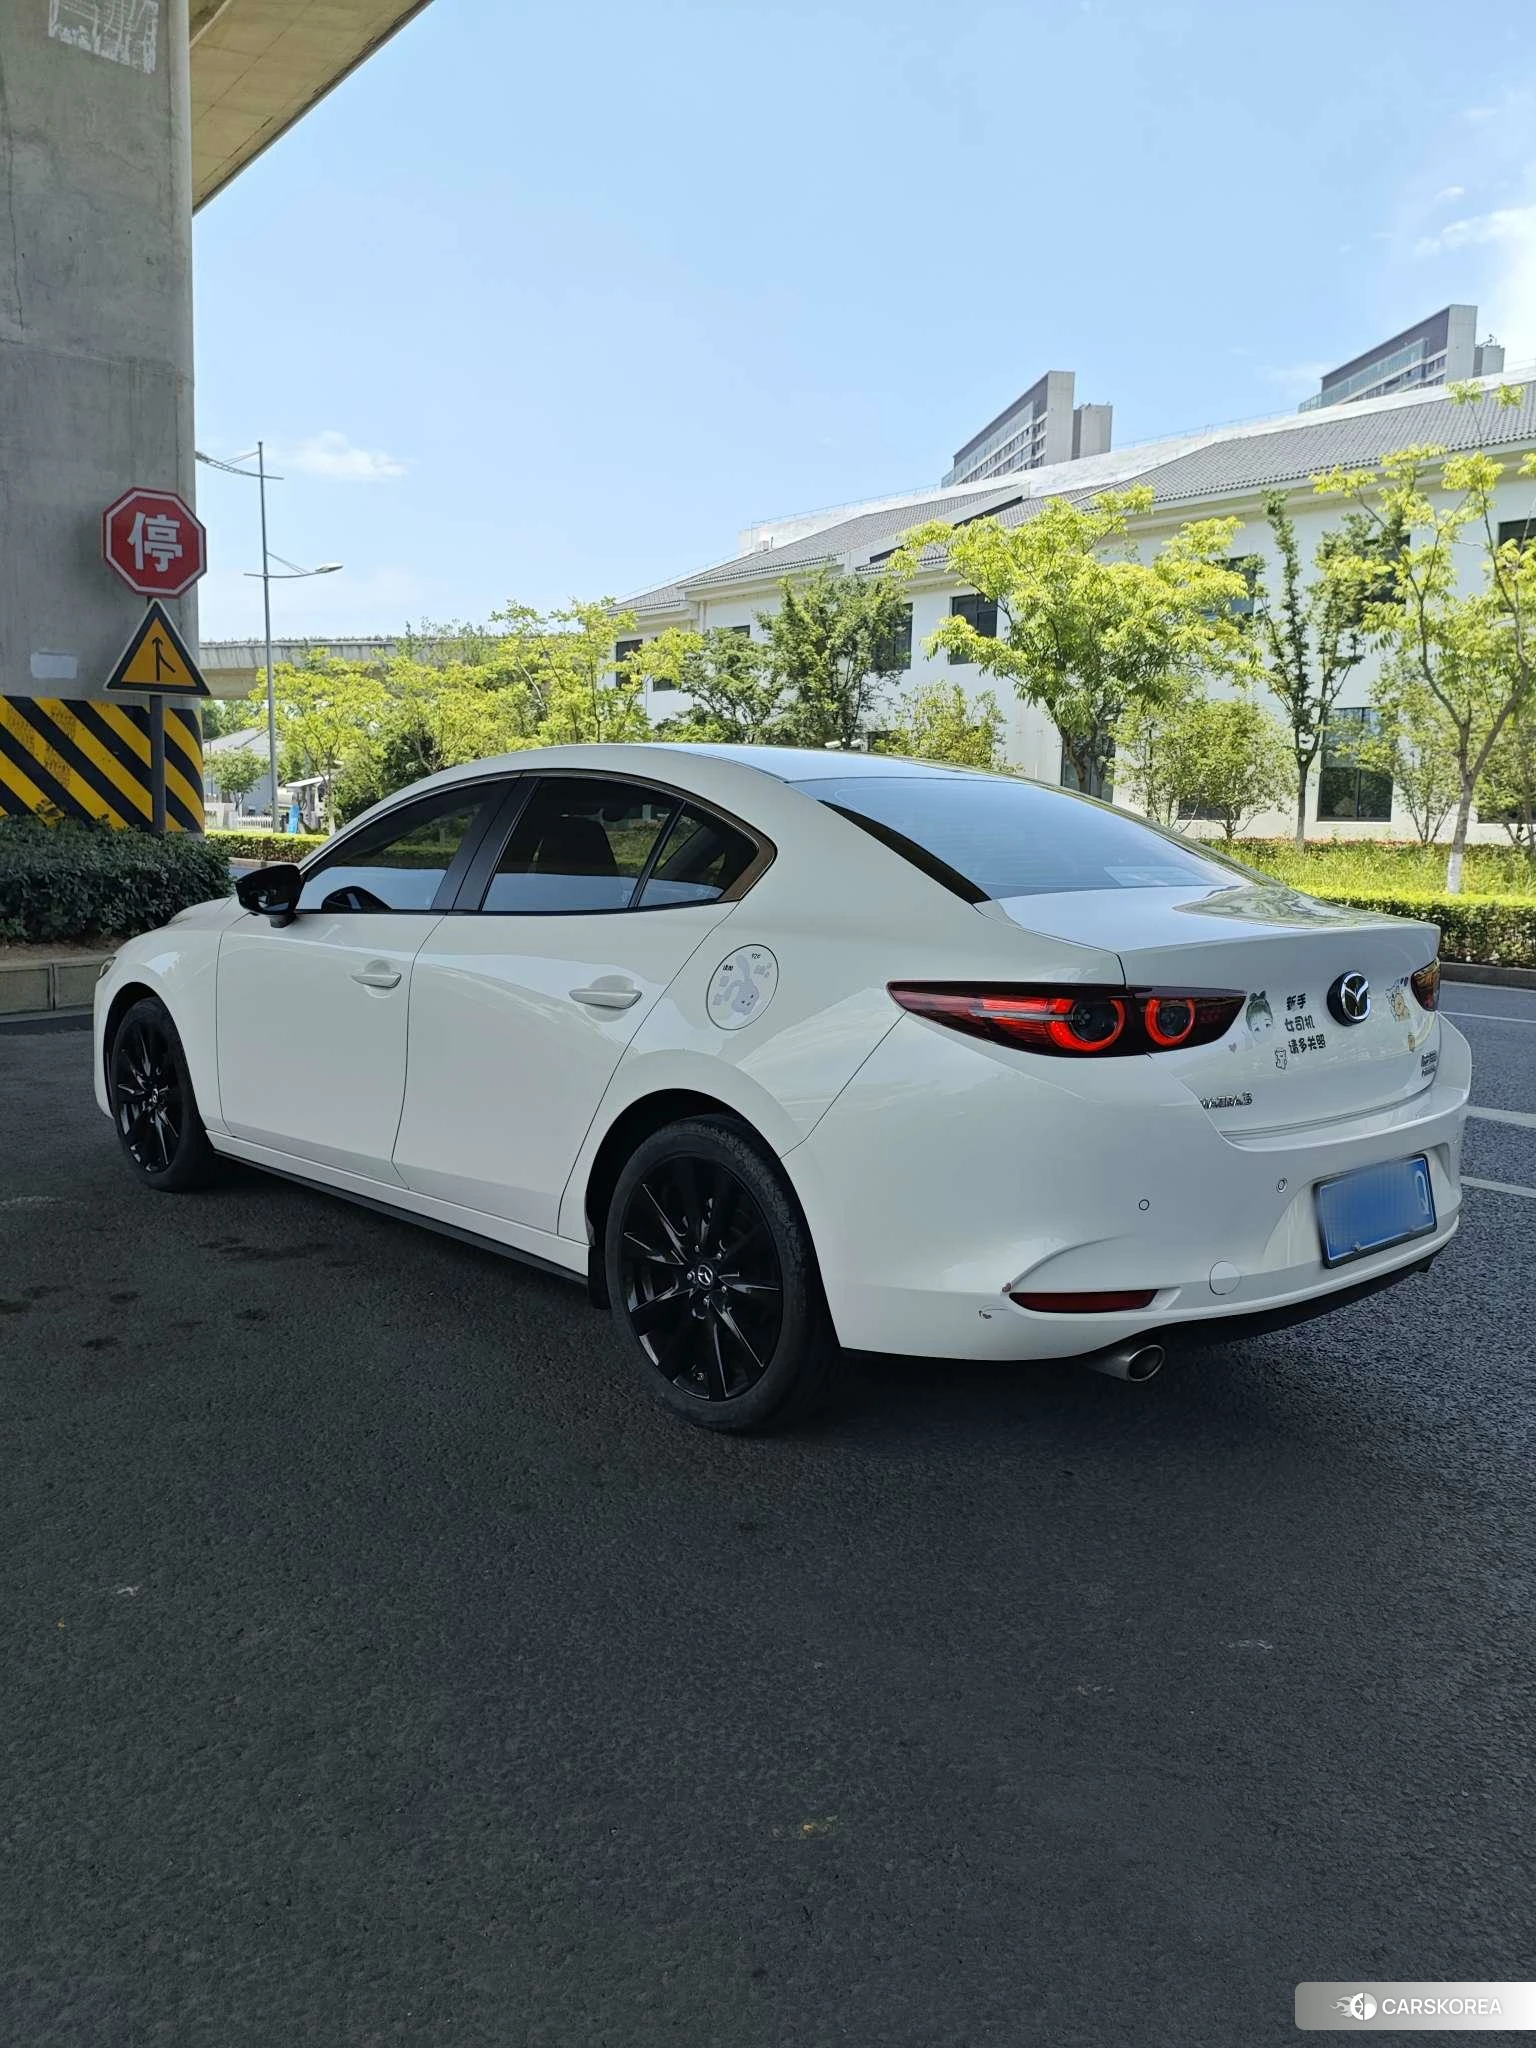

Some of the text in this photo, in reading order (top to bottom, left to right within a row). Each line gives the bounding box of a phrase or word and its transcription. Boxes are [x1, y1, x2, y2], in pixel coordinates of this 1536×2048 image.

[127, 511, 183, 572] 停
[1286, 993, 1306, 1011] 新手
[1284, 1014, 1315, 1032] 女司机
[1288, 1033, 1326, 1054] 请多关照
